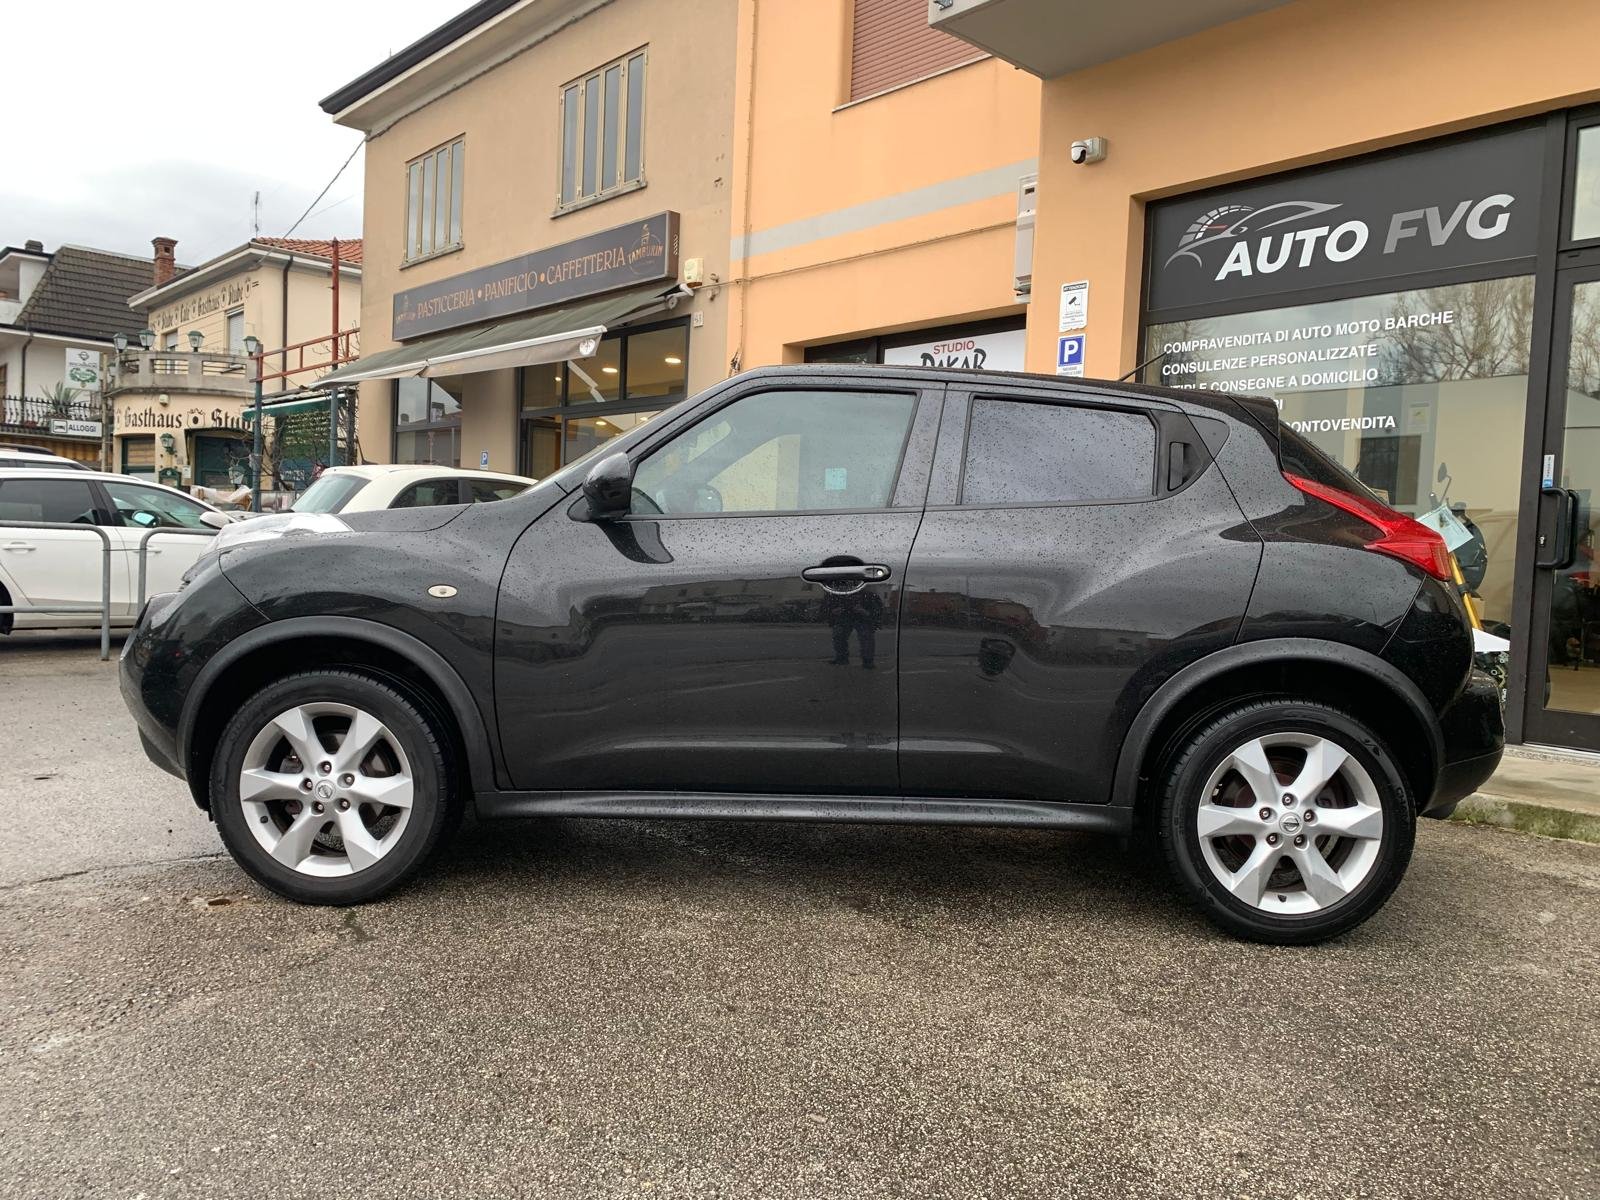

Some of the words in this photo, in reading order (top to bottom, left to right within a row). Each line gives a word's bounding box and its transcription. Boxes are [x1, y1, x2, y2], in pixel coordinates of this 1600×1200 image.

[1215, 220, 1369, 281] AUTO
[1383, 193, 1516, 254] FVG
[416, 288, 475, 319] PASTICCERIA
[484, 270, 538, 302] PANIFICIO
[546, 246, 626, 286] CAFFETTERIA
[1163, 332, 1272, 355] COMPRAVENDITA
[1275, 330, 1288, 342] DI
[1291, 324, 1332, 340] AUTO
[1336, 319, 1380, 336] MOTO
[1384, 310, 1454, 330] BARCHE
[933, 340, 975, 355] STUDIO
[1063, 339, 1079, 363] P
[1162, 356, 1248, 376] CONSULENZE
[1250, 344, 1378, 368] PERSONALIZZATE
[1210, 377, 1285, 392] CONSEGNE
[1288, 374, 1298, 387] A
[1301, 368, 1379, 386] DOMICILIO
[68, 424, 97, 433] ALLOGGI
[125, 406, 183, 429] Gasthaus
